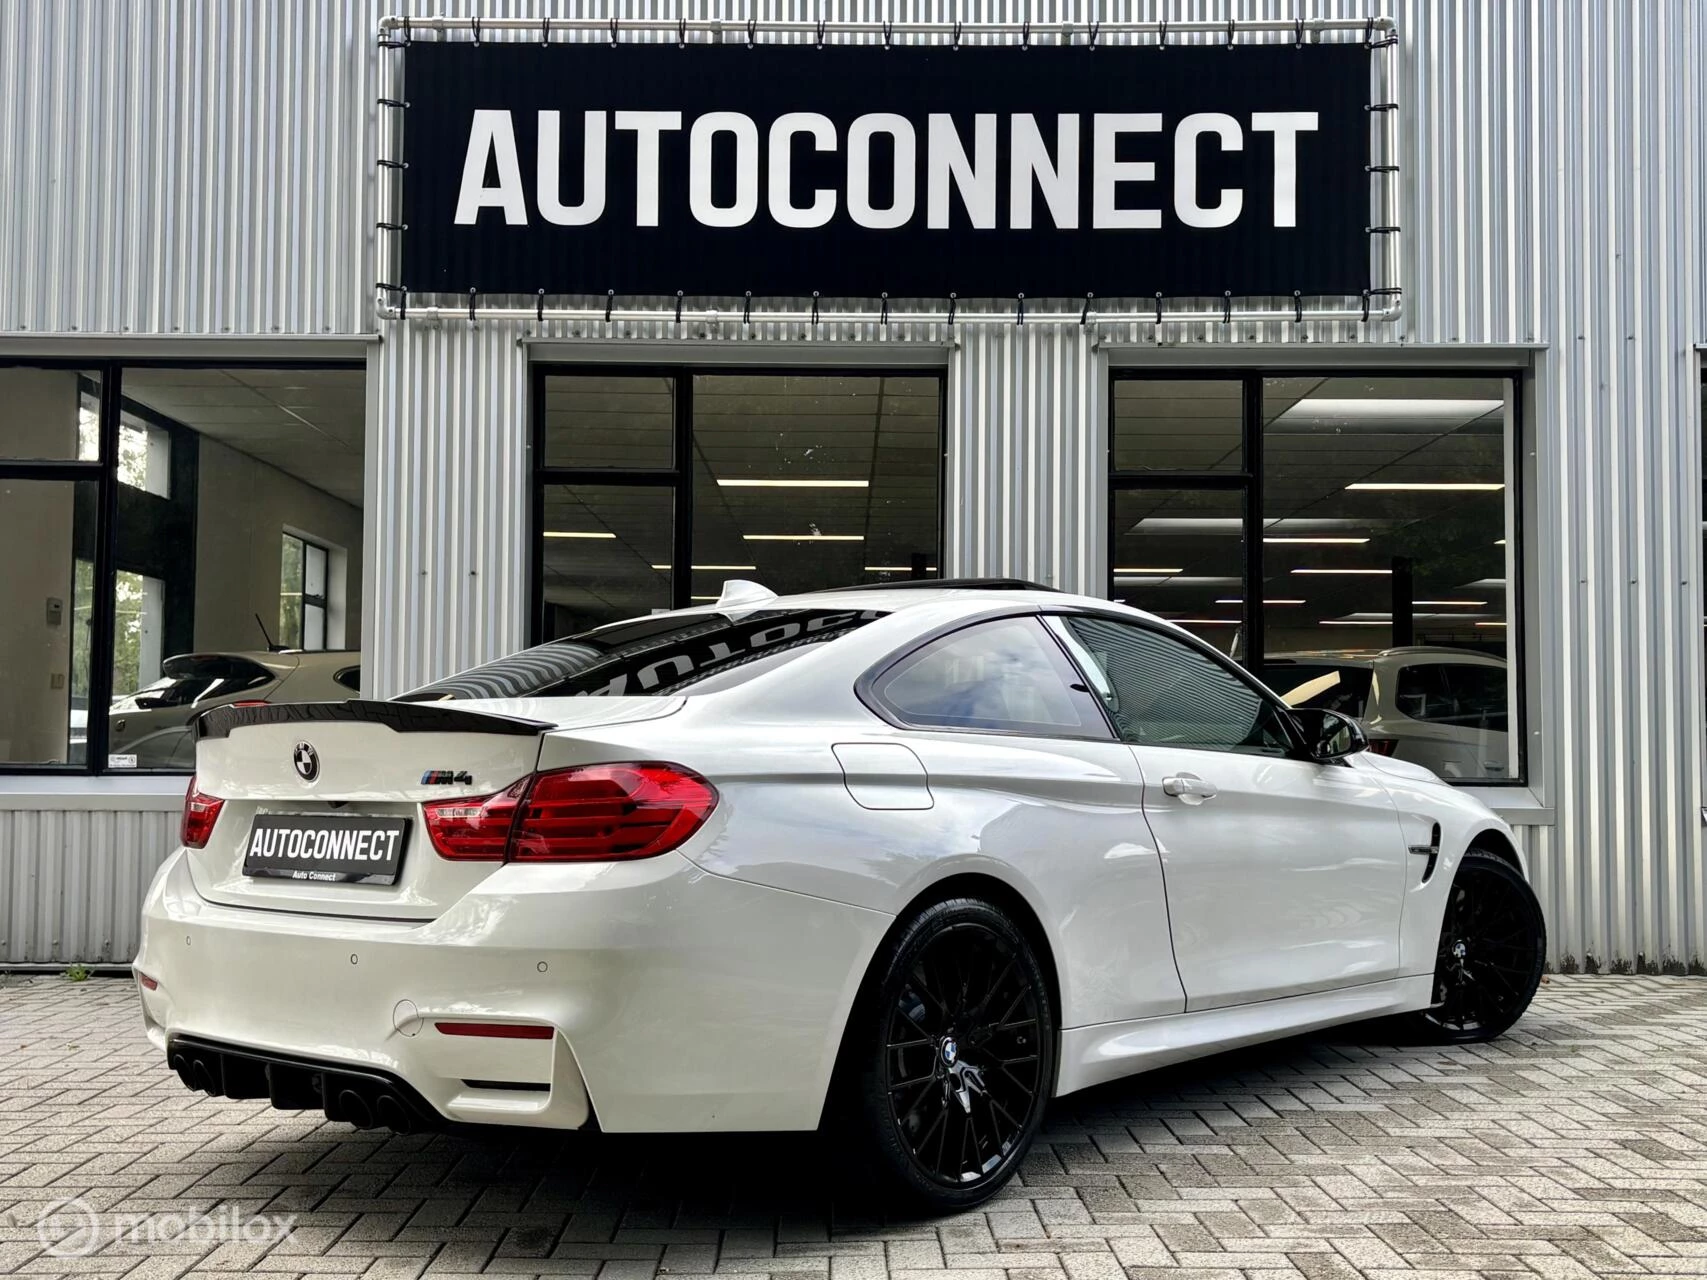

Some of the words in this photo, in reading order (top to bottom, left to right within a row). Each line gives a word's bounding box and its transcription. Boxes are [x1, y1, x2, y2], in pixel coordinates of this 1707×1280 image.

[454, 109, 1319, 231] AUTOCONNECT
[249, 828, 400, 861] AUTOCONNECT
[292, 870, 308, 879] Auto
[309, 871, 336, 881] Connect
